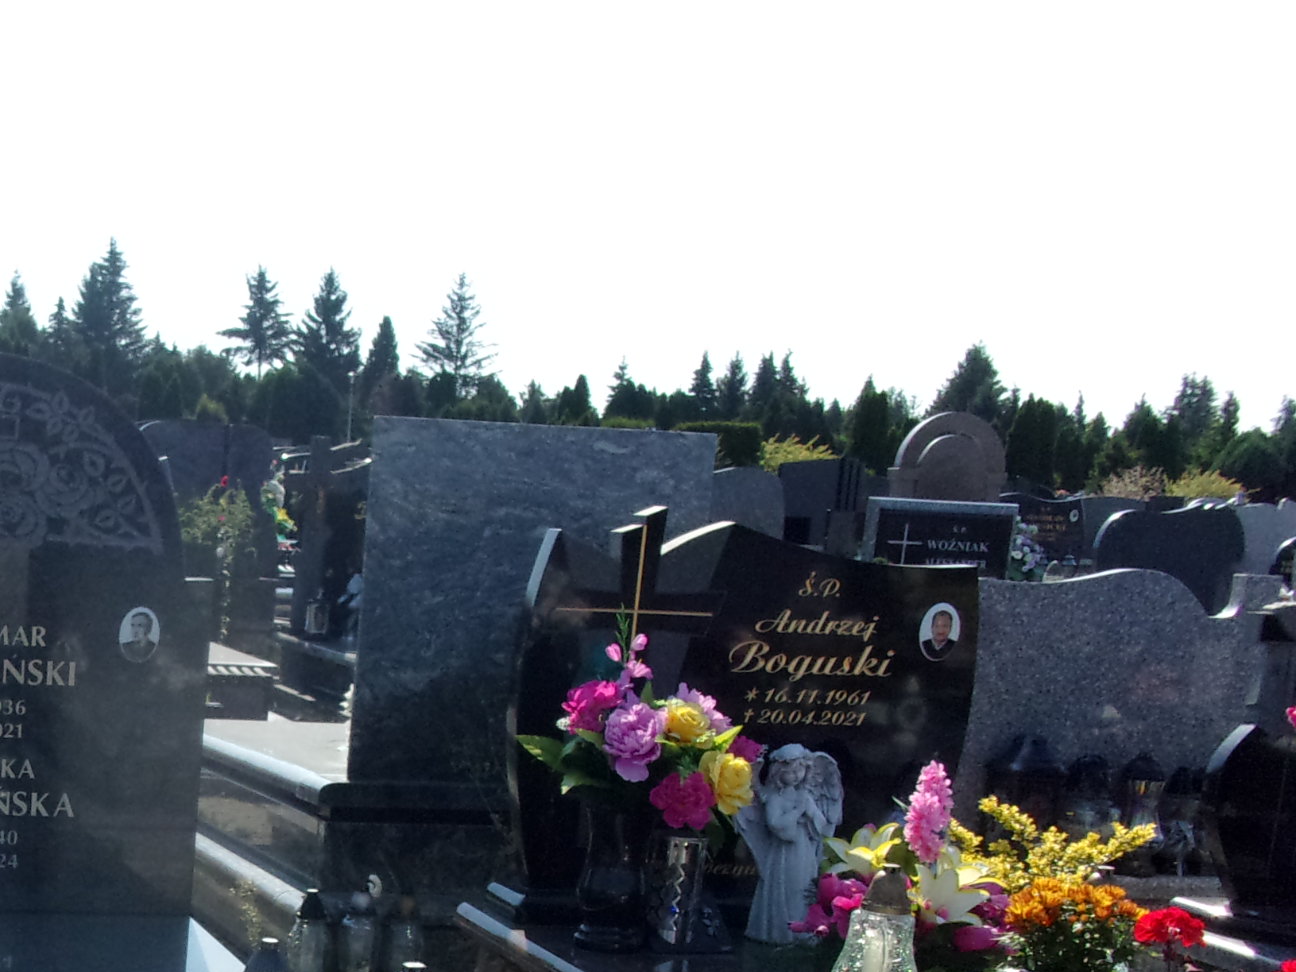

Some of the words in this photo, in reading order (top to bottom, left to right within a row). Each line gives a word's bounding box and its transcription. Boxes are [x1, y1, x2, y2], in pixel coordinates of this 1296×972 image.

[927, 537, 990, 553] WOŹNIAK
[755, 608, 880, 642] Andrzej
[728, 640, 896, 682] Boguski
[764, 687, 872, 706] 16.11.1961
[757, 708, 867, 726] 20.04.2021
